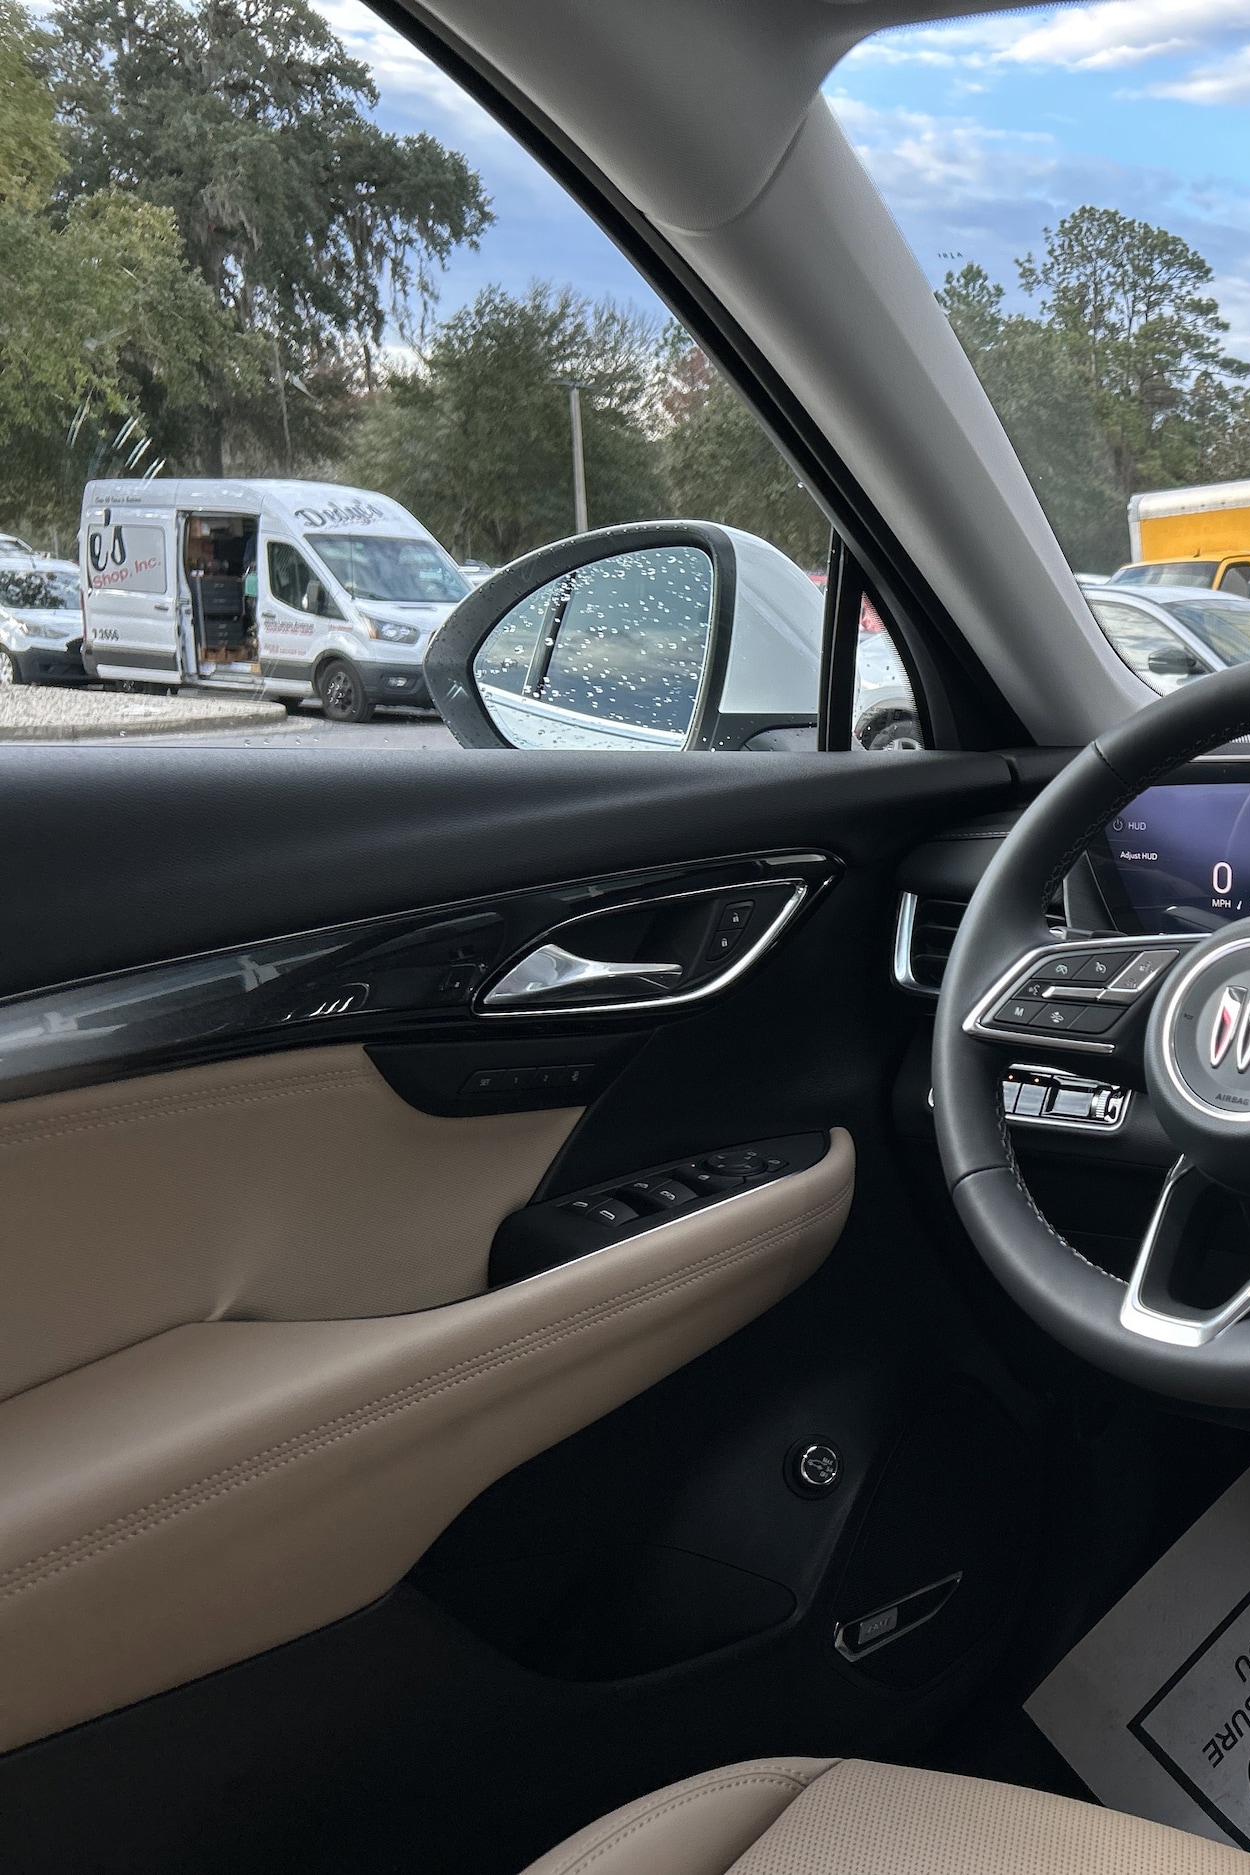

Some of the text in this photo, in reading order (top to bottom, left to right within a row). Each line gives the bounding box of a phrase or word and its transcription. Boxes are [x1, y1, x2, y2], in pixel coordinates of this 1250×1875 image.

[134, 556, 161, 574] Inc.
[1128, 821, 1147, 831] HUD
[1119, 851, 1158, 861] Adjust HUD
[1212, 861, 1233, 894] 0
[1211, 899, 1232, 909] MPH
[1215, 1093, 1250, 1106] AIRBAG
